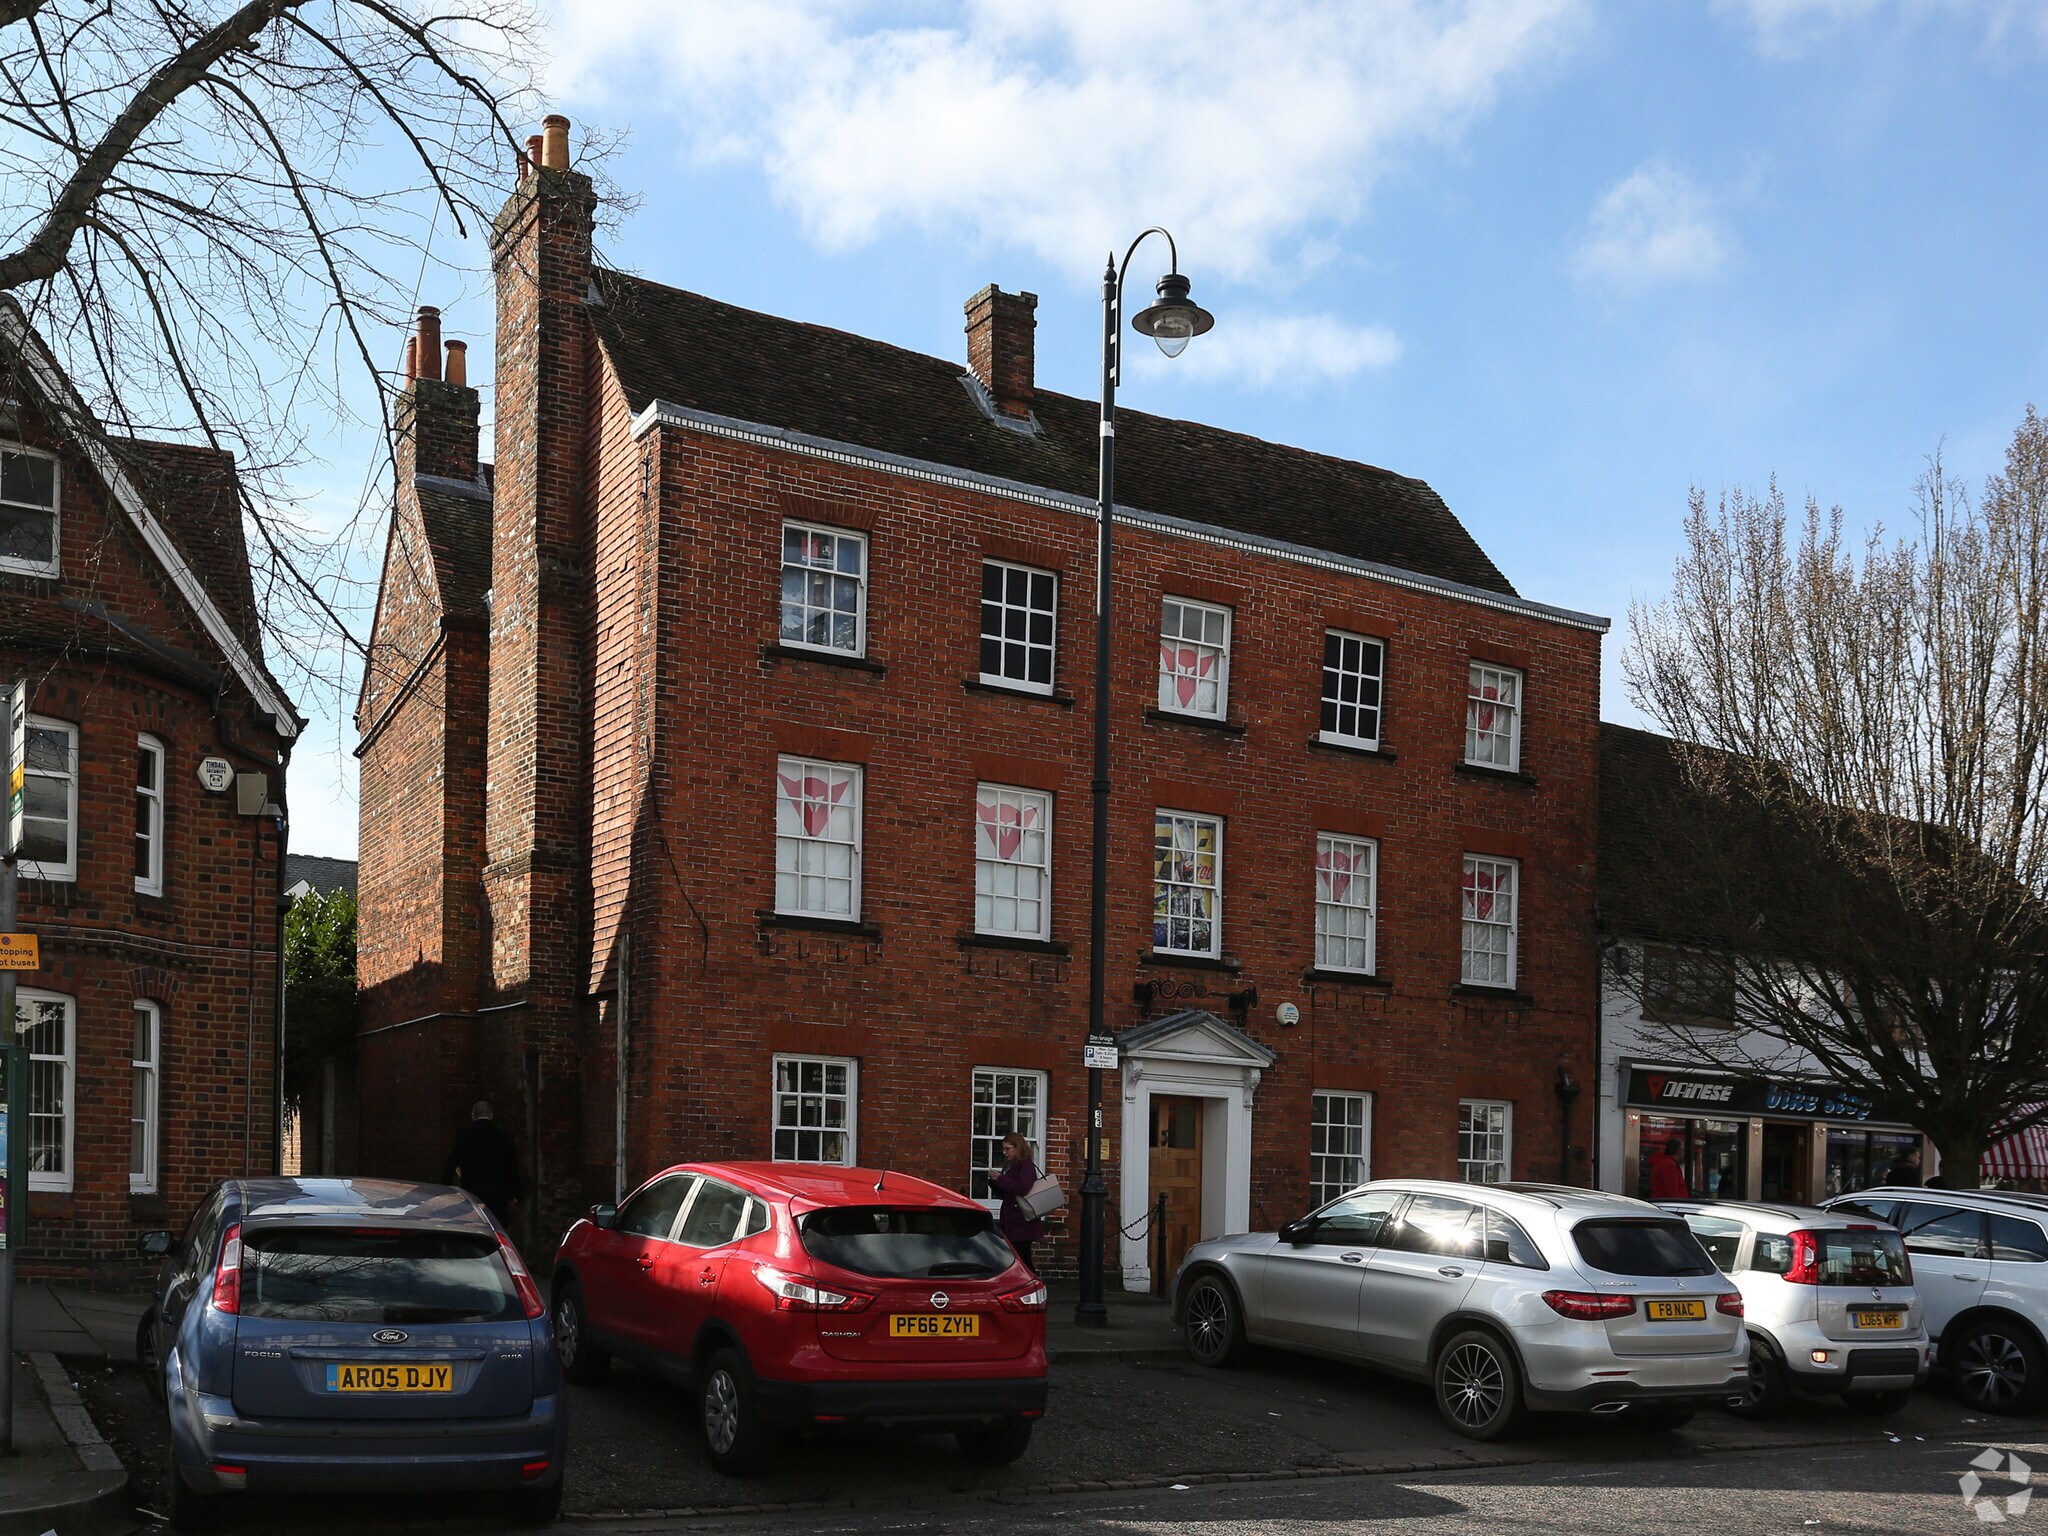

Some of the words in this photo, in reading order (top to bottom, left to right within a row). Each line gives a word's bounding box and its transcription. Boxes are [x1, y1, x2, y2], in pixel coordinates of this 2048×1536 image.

[205, 761, 227, 769] TINDALL
[10, 959, 36, 967] buses
[1087, 1048, 1093, 1057] P
[1659, 1303, 1673, 1316] F8
[1674, 1302, 1694, 1316] NAC
[1883, 1312, 1898, 1325] WPF
[896, 1317, 938, 1333] PF66
[943, 1317, 973, 1333] ZYH
[380, 1332, 400, 1341] Ford
[244, 1350, 282, 1358] FOCUS
[341, 1367, 400, 1389] AR05
[406, 1367, 448, 1389] DJY
